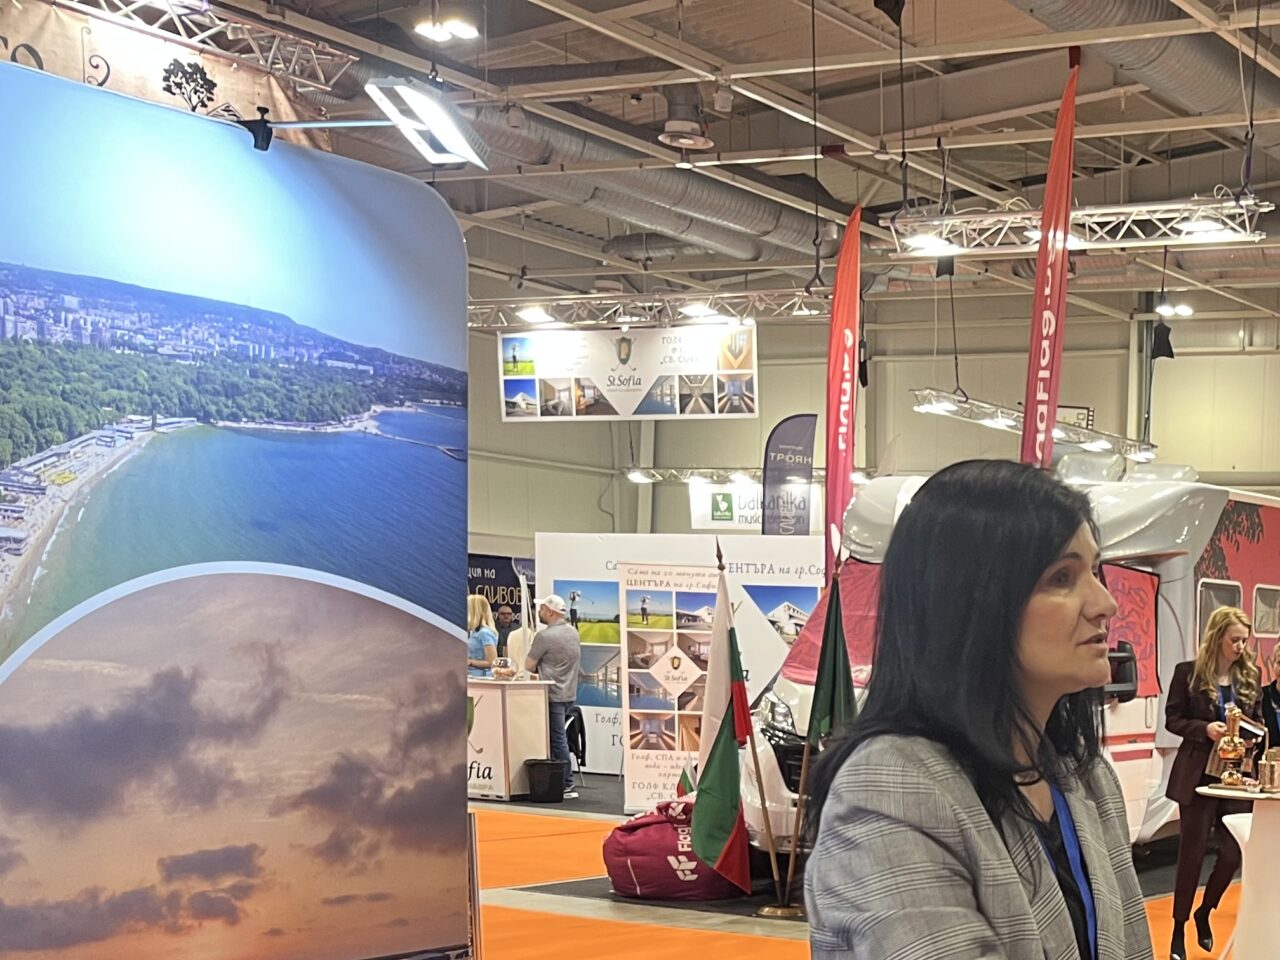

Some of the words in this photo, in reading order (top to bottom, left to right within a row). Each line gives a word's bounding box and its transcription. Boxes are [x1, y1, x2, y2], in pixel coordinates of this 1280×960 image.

[616, 374, 642, 388] Sofia
[769, 452, 812, 464] ТРОЯН
[726, 562, 775, 575] ЕНТЪРА
[779, 566, 791, 575] на
[626, 578, 671, 588] ЦЕНТЪРА
[467, 760, 494, 780] fia
[632, 781, 659, 790] ГОЛФ
